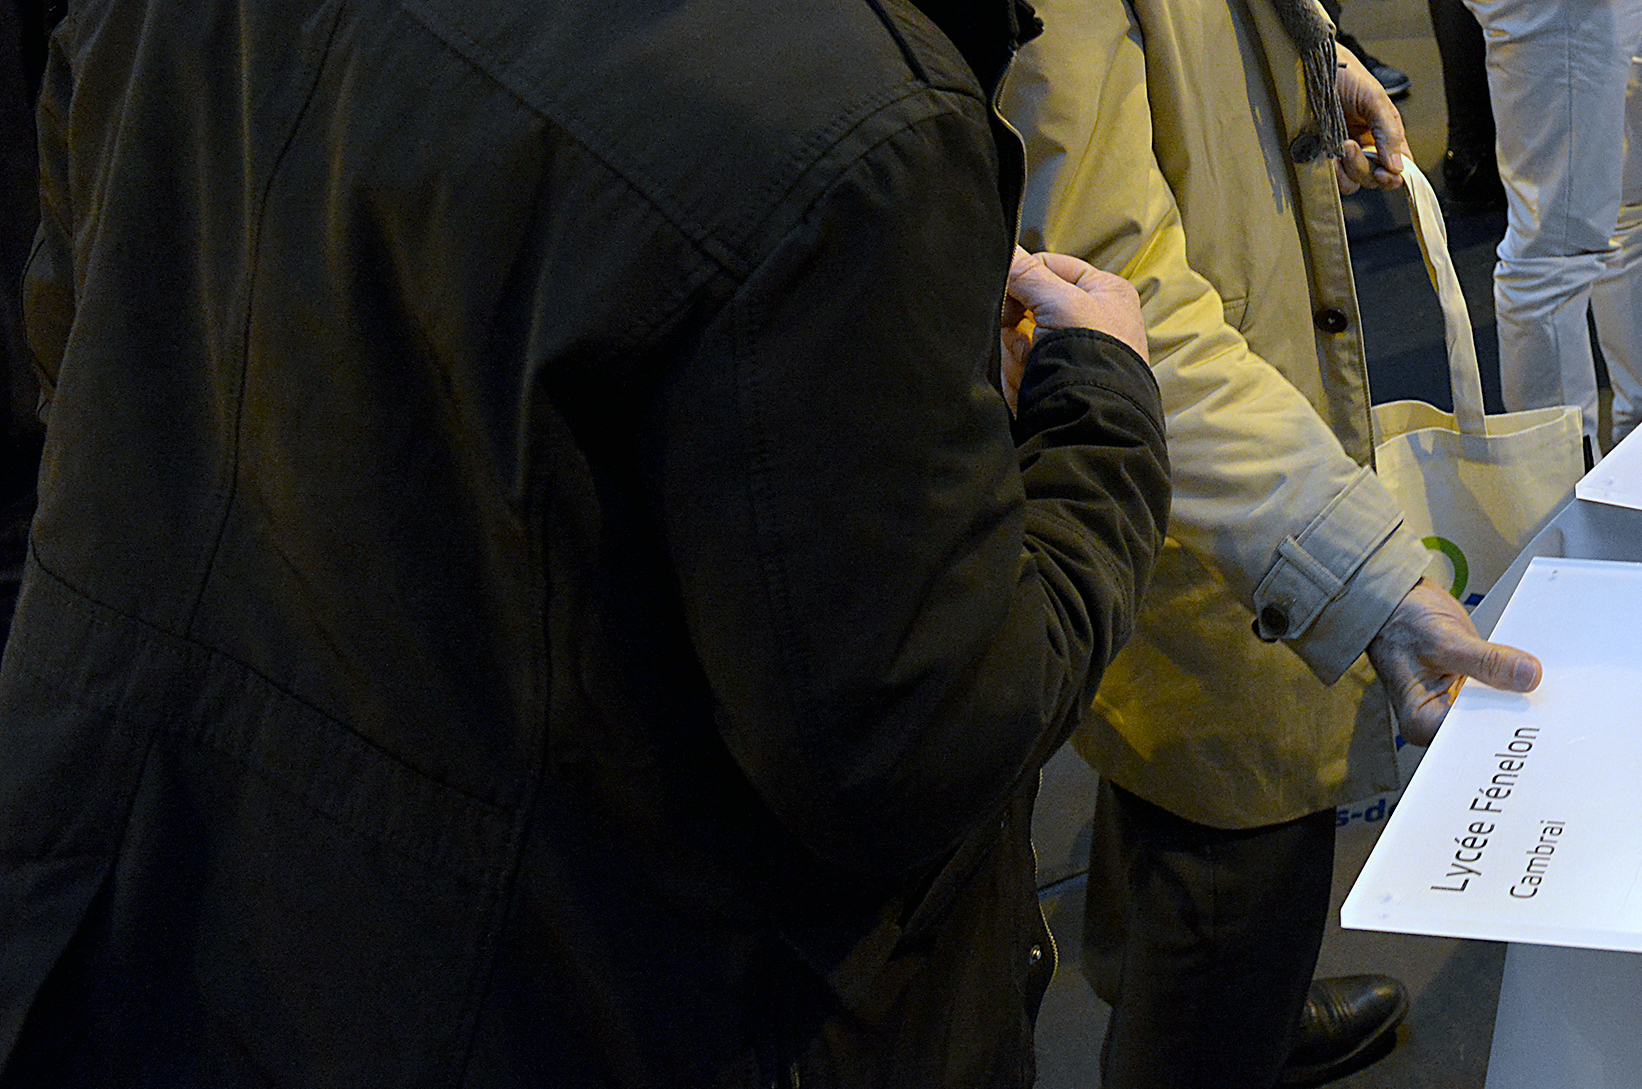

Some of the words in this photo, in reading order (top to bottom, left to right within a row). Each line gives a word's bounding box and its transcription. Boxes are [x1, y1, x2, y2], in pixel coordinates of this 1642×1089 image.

[1429, 821, 1496, 893] Lycée
[1468, 726, 1541, 814] Fénelon
[1508, 819, 1567, 900] Cambrai
